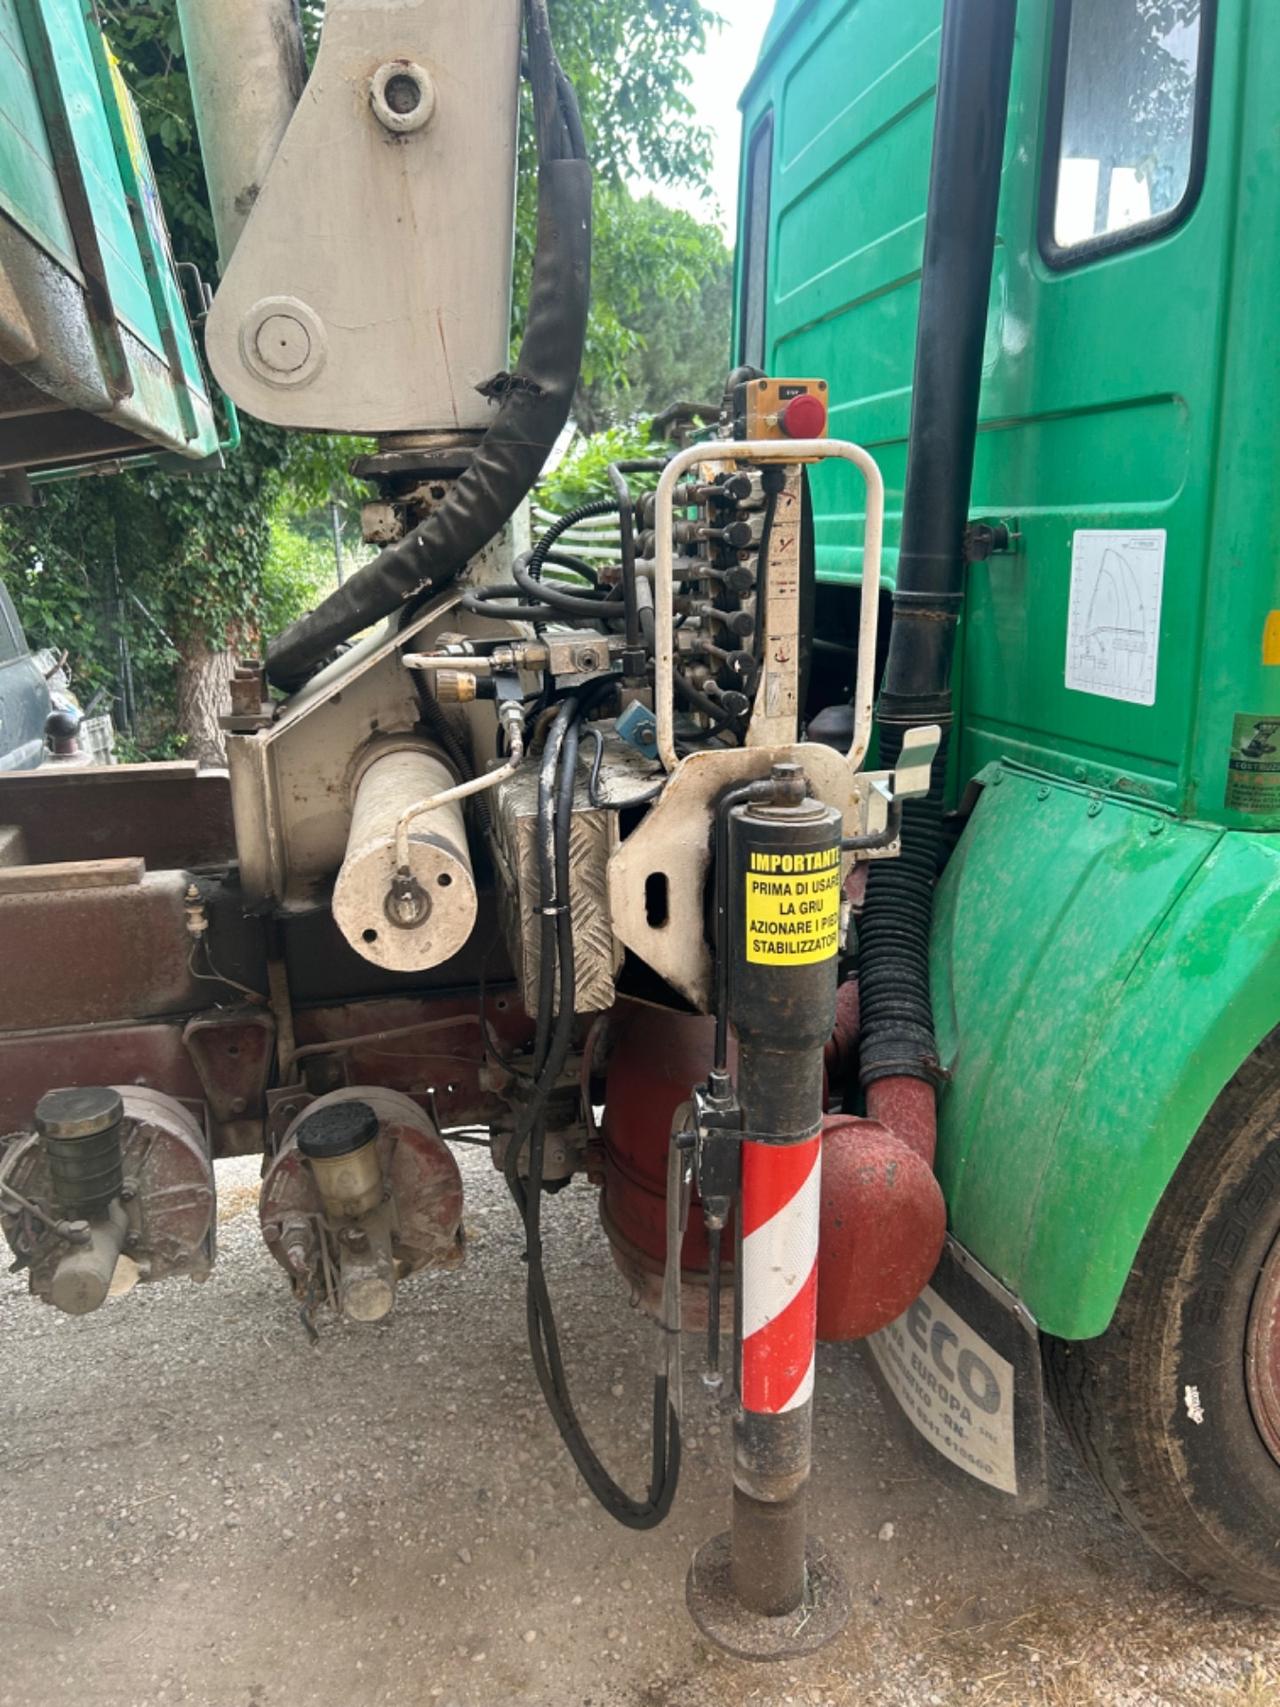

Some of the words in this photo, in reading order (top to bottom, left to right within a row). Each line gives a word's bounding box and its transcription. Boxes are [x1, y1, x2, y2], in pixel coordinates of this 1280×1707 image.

[752, 881, 792, 896] PRIMA
[796, 882, 808, 895] DI
[779, 902, 796, 915] LA
[799, 899, 824, 914] GRU
[749, 919, 812, 935] AZIONARE
[815, 919, 819, 932] I
[752, 932, 837, 954] STABILIZZATOR
[906, 1297, 1001, 1415] ECO
[911, 1351, 973, 1426] EUROPA
